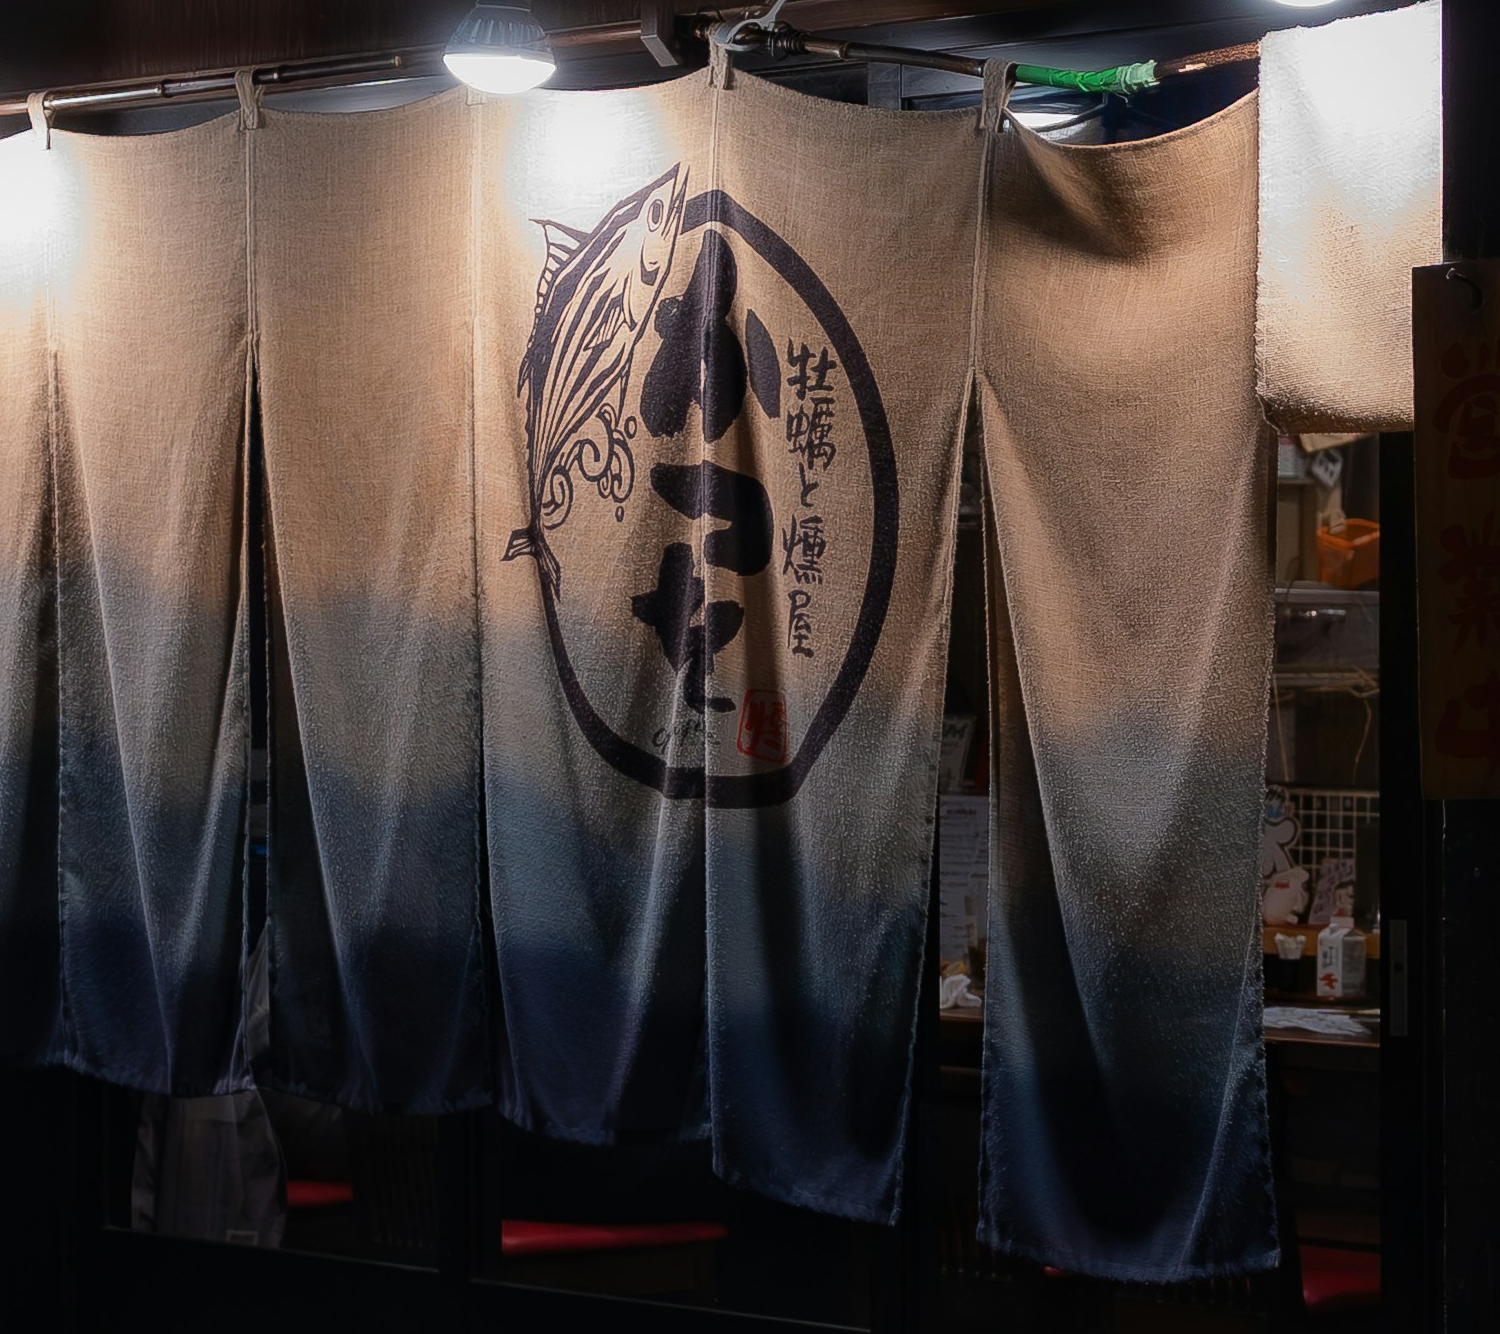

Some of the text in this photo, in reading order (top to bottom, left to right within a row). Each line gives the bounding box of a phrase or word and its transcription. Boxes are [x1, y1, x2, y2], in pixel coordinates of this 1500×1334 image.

[630, 227, 783, 716] かつを
[781, 338, 838, 658] 牡蠣と燻屋
